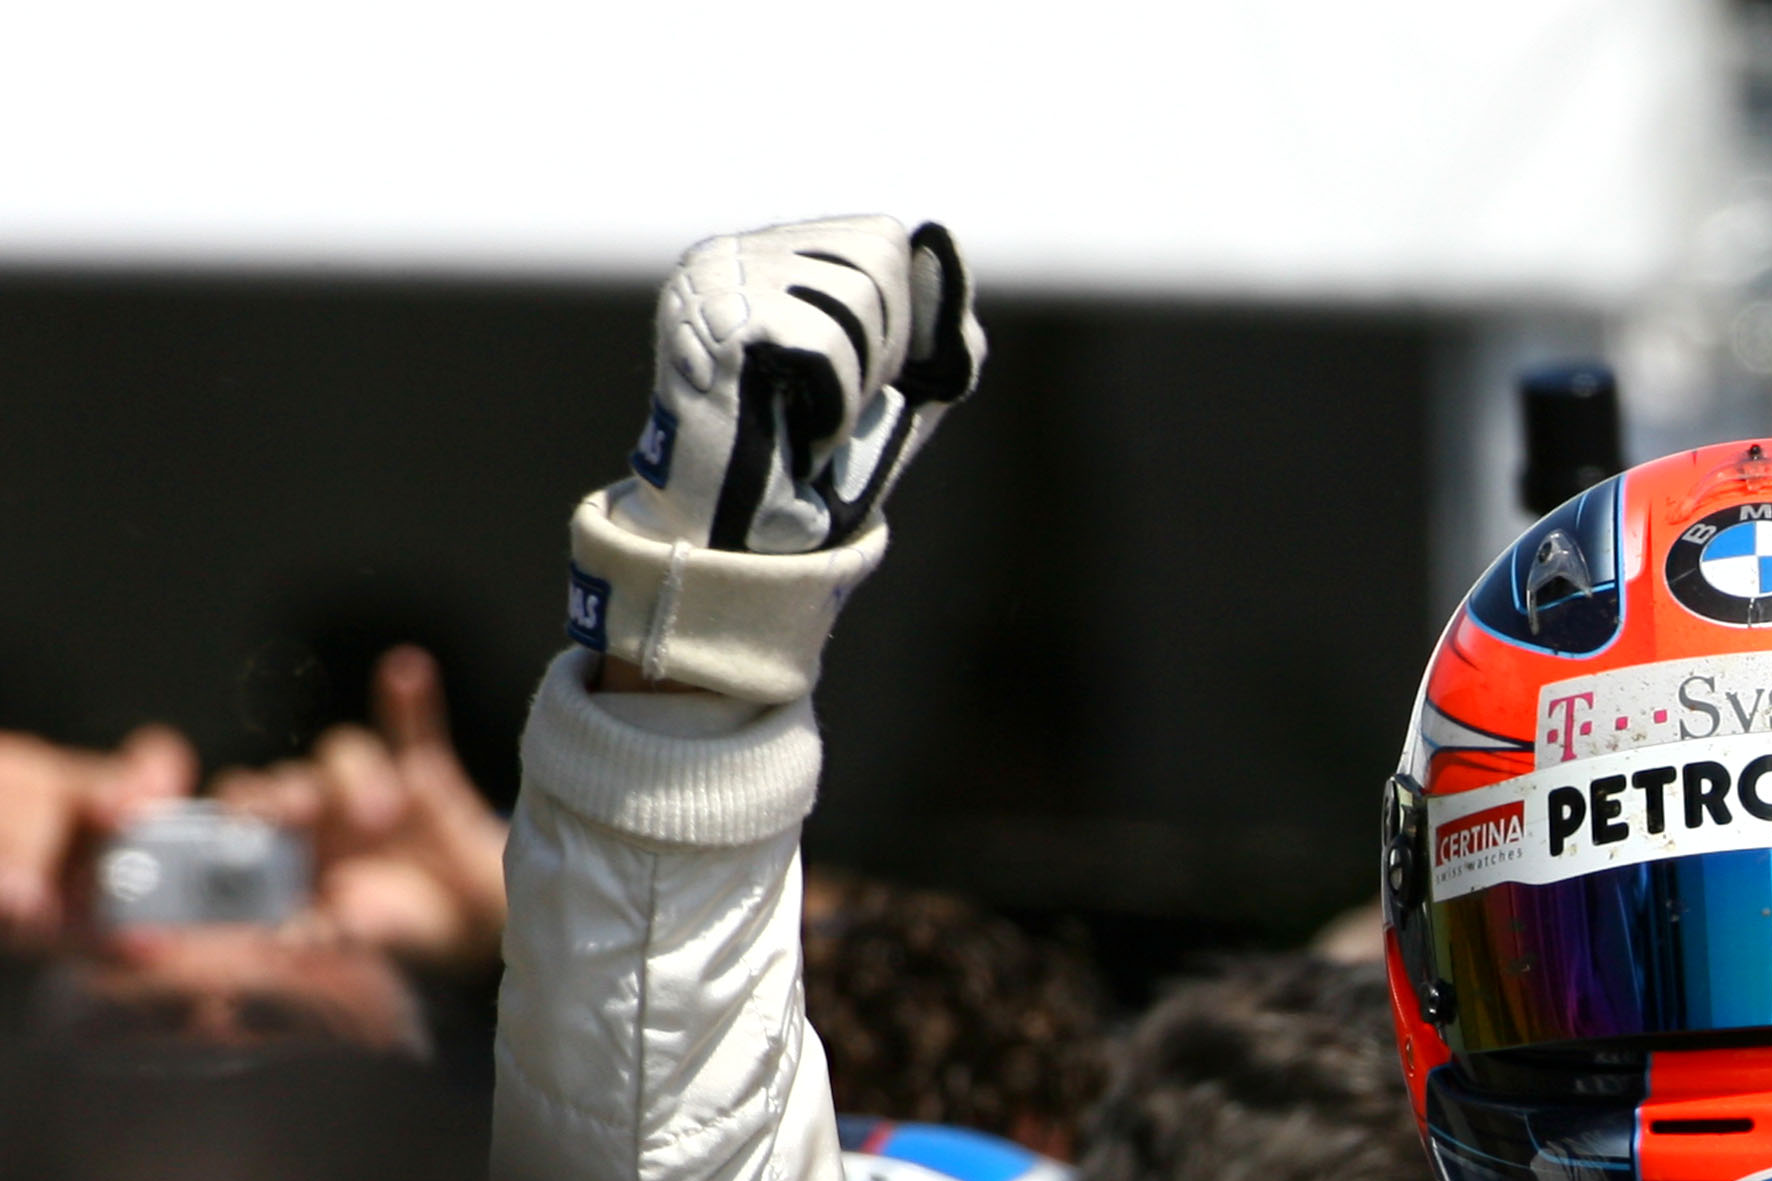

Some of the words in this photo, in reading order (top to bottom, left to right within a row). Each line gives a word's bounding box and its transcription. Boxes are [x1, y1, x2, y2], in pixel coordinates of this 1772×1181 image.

[1440, 813, 1524, 866] CERTINA
[1436, 865, 1463, 885] swiss
[1466, 846, 1523, 872] watches
